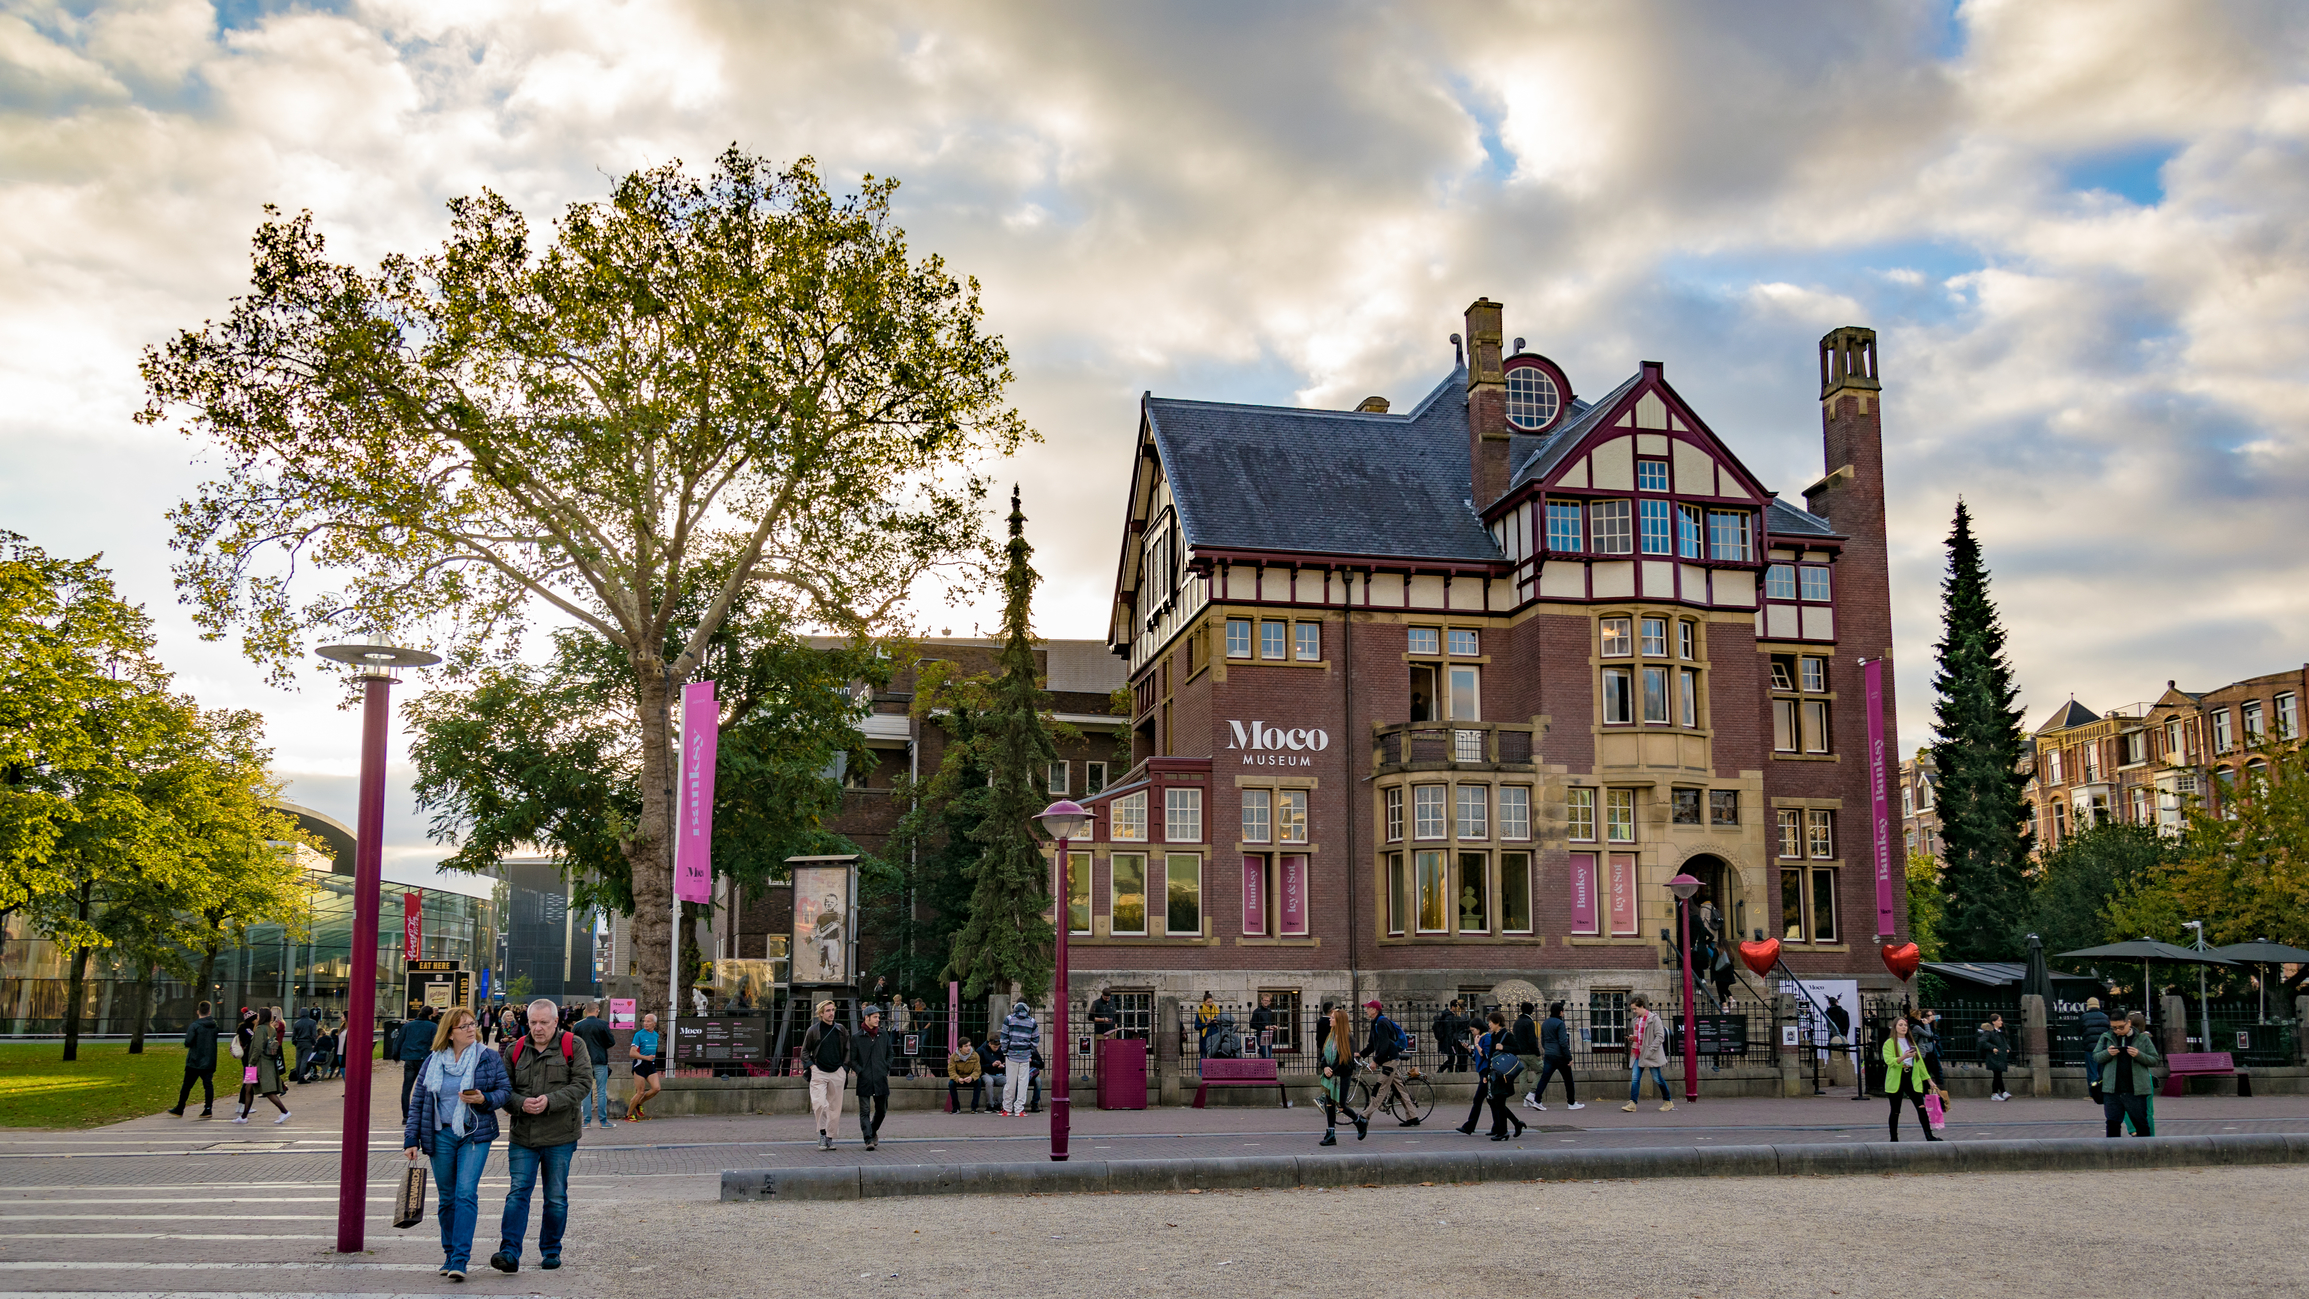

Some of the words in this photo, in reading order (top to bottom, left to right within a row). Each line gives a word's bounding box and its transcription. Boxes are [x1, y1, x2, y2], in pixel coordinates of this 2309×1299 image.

[1225, 720, 1329, 751] Moco
[1243, 755, 1310, 767] MUSEUM
[1873, 738, 1884, 801] Banksy
[1877, 816, 1888, 880] Banksy
[1287, 865, 1296, 883] Sot
[1613, 864, 1622, 882] Sot
[1249, 868, 1257, 909] Banksy
[1287, 885, 1296, 895] &
[1576, 866, 1587, 908] Banksy
[1614, 883, 1623, 894] &
[1287, 896, 1298, 913] Icy
[1614, 895, 1625, 911] Icy
[460, 978, 468, 994] COLD
[409, 1169, 420, 1208] REWARDS
